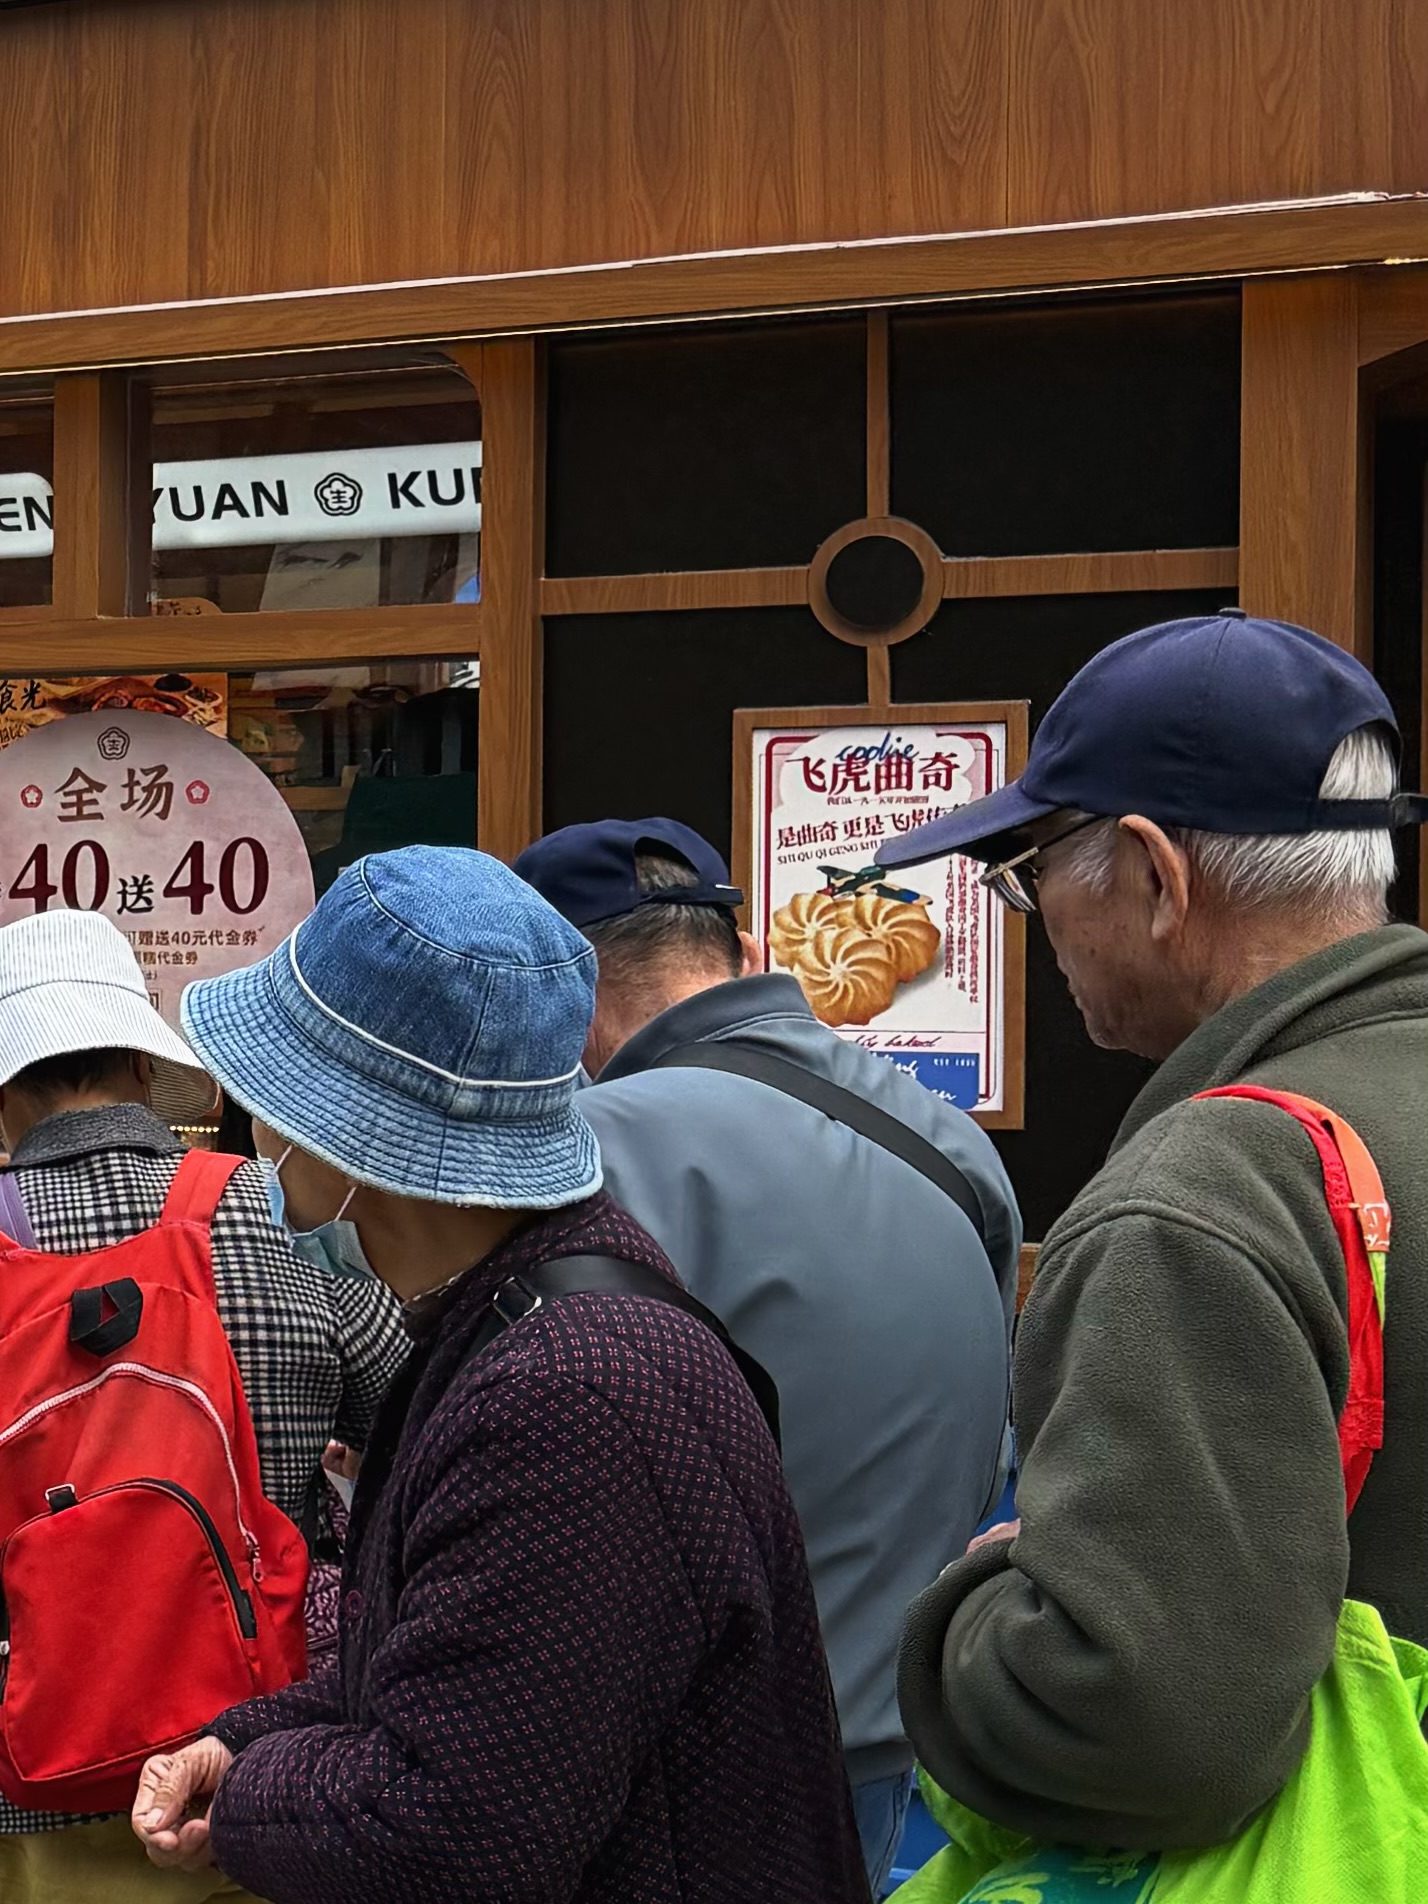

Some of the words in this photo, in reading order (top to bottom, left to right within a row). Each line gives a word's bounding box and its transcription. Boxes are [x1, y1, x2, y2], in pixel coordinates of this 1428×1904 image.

[54, 763, 175, 823] 全场
[785, 751, 960, 795] 飞虎曲奇
[776, 820, 838, 850] 是曲奇
